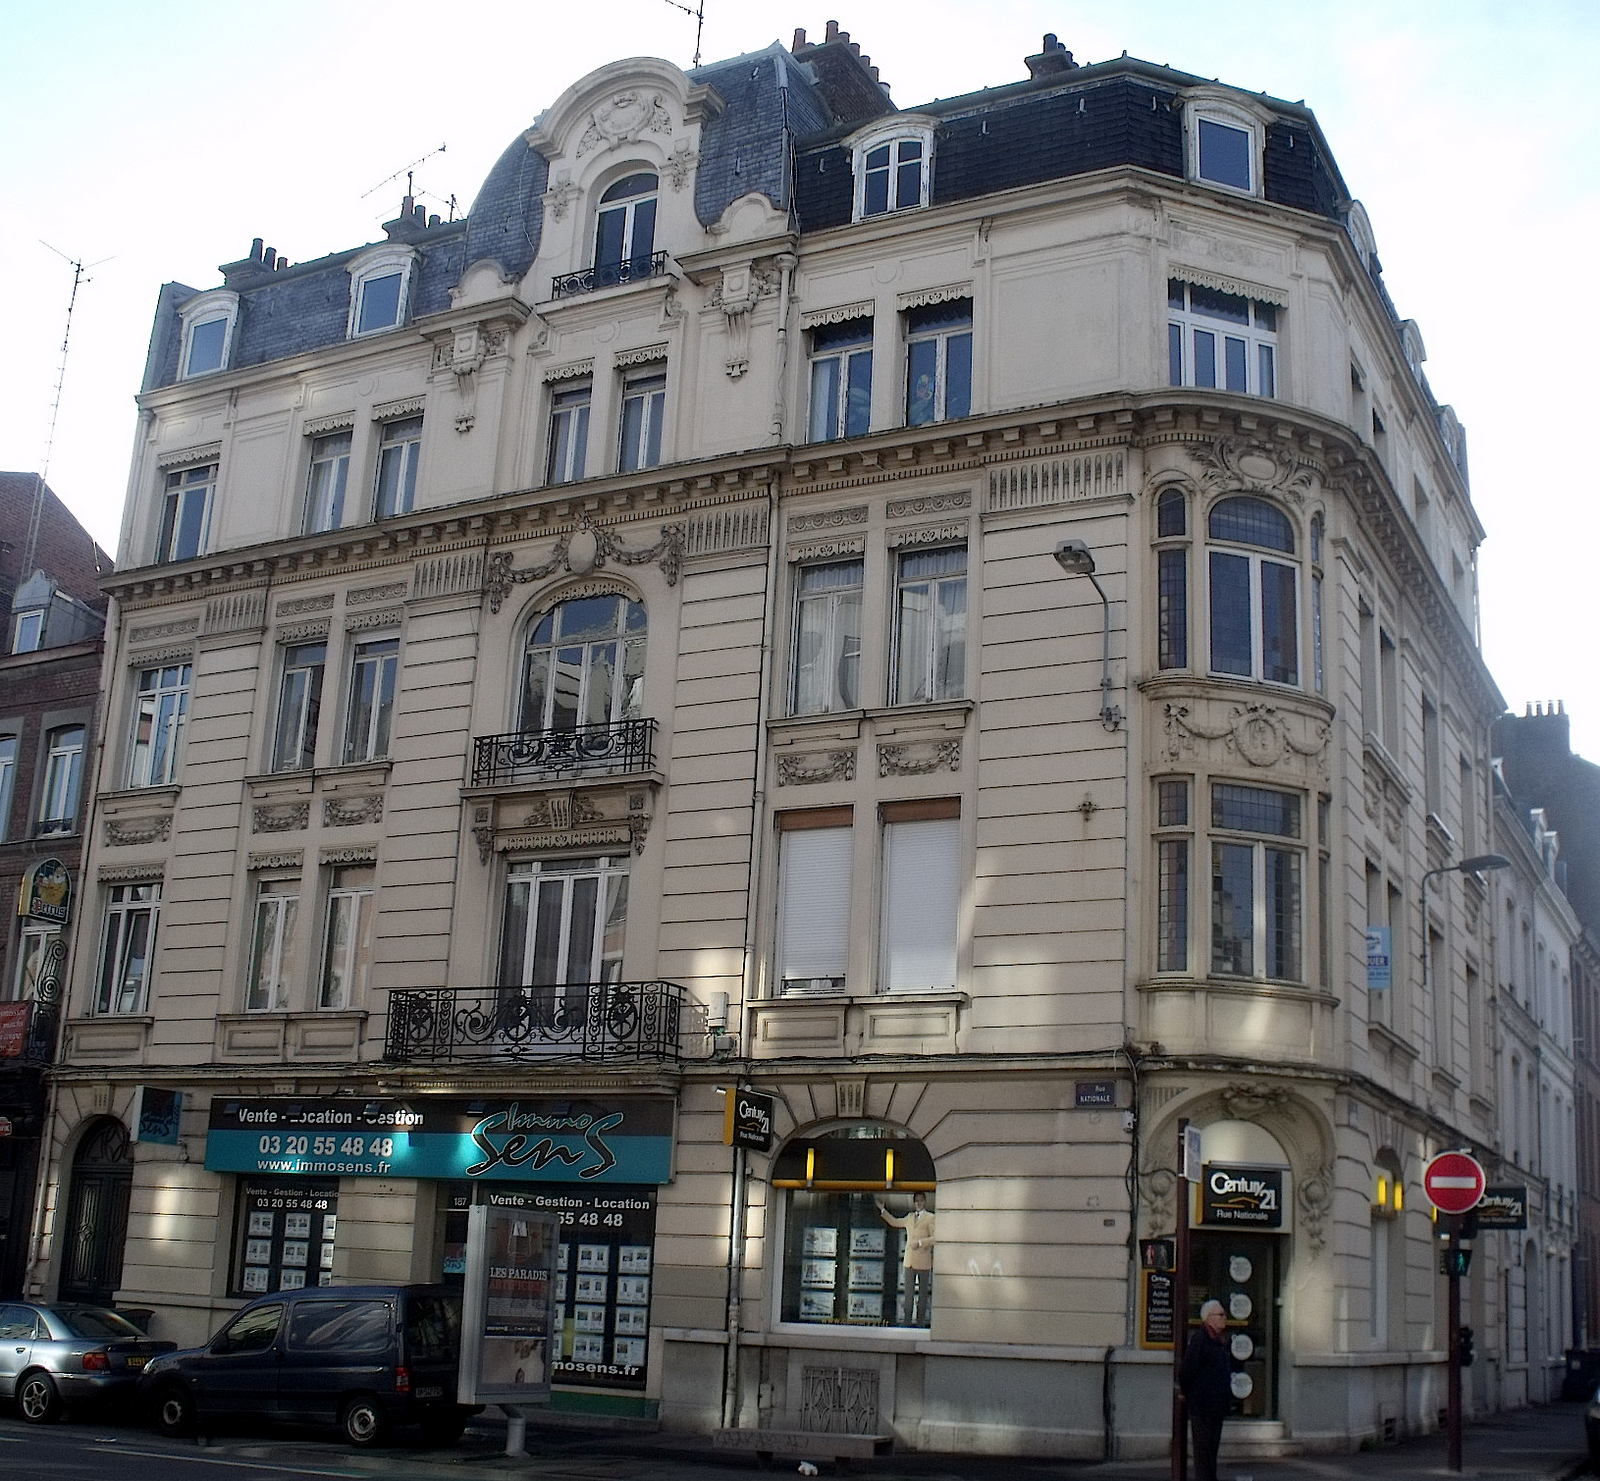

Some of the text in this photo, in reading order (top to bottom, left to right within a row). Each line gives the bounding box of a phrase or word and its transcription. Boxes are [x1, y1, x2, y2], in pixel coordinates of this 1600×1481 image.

[31, 897, 67, 918] Petrus
[1080, 1094, 1111, 1102] NATIONALE
[239, 1108, 278, 1123] Vente
[290, 1109, 353, 1124] ocation
[761, 1117, 770, 1134] 21
[259, 1135, 394, 1157] 03 20 55 48 48
[257, 1158, 391, 1174] www.immosens.fr
[246, 1187, 268, 1195] Vente
[273, 1188, 304, 1197] Gestion
[1211, 1172, 1276, 1211] Century 21
[257, 1198, 328, 1209] 03 20 55 48 48
[489, 1194, 525, 1206] Vente
[535, 1195, 584, 1208] Gestion
[594, 1198, 651, 1210] Location
[579, 1212, 599, 1226] 48
[603, 1213, 623, 1227] 48
[1216, 1209, 1269, 1221] Rue Nationale
[489, 1266, 548, 1281] LES PARADIS
